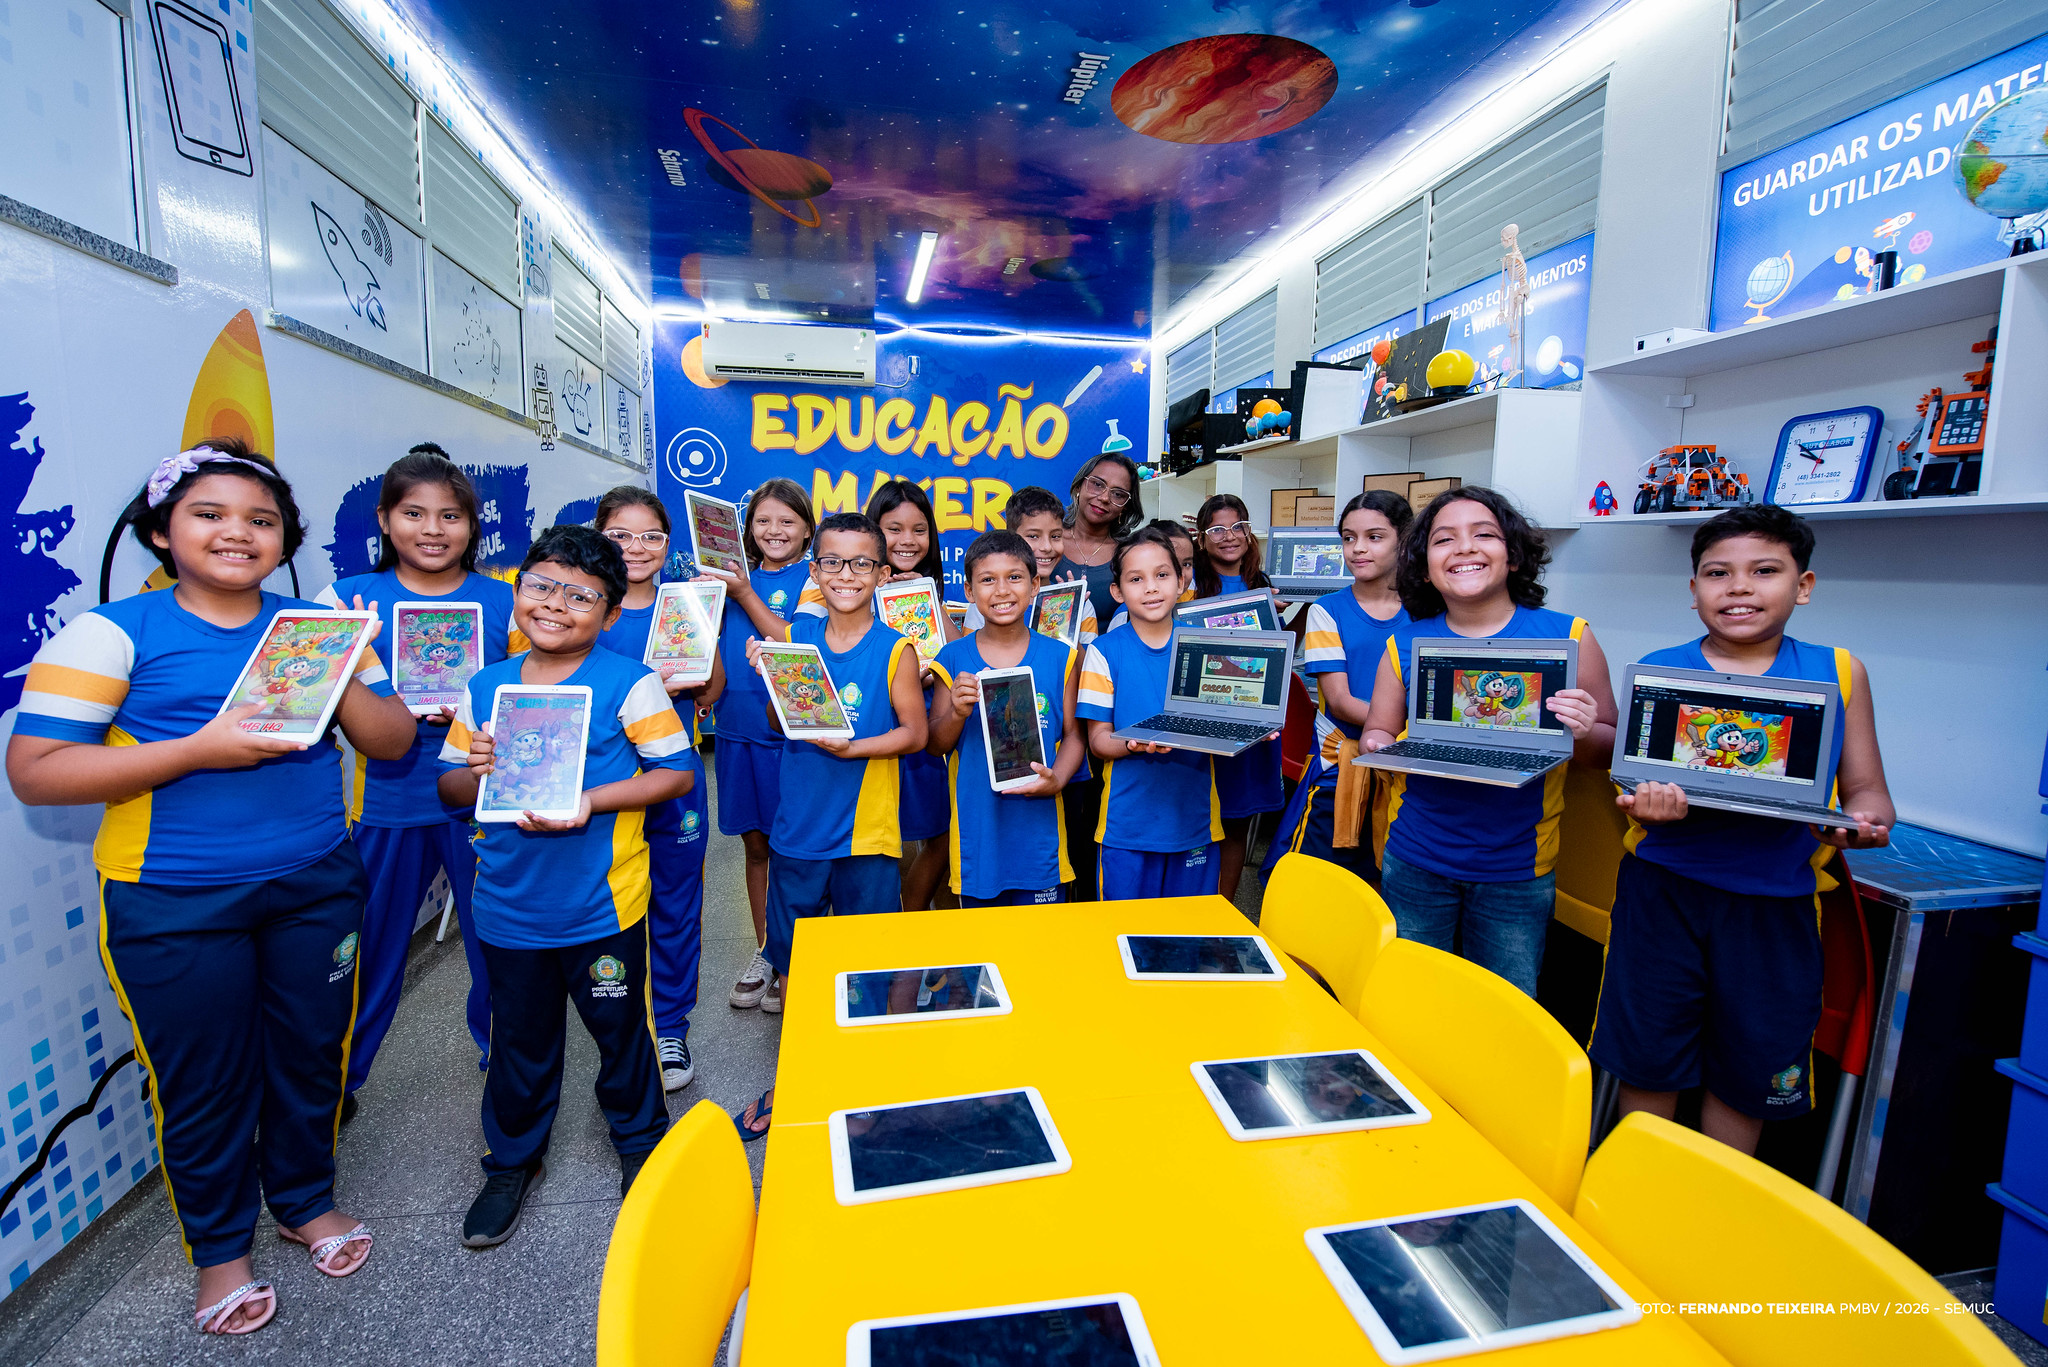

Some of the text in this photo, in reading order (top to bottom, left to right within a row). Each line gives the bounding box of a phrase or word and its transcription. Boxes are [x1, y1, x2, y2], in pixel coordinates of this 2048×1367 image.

[1063, 51, 1110, 105] Júpiter
[1732, 58, 2048, 207] GUARDAR OS MATE
[1808, 144, 1960, 217] UTILIZAD
[1002, 257, 1026, 275] Urano
[1461, 298, 1484, 318] DOS
[1463, 322, 1471, 338] E
[751, 380, 1070, 466] EDUCAÇÃO
[1785, 462, 1792, 470] 9
[1780, 482, 1787, 490] 8
[1790, 493, 1797, 501] 7
[418, 612, 473, 624] CASCÃO
[294, 619, 363, 633] CASCÃO
[773, 652, 818, 664] CASCÃO
[1201, 683, 1232, 694] CASCÃO
[262, 721, 284, 732] HQ
[591, 984, 628, 992] PREFEITURA
[608, 990, 628, 998] VISTA
